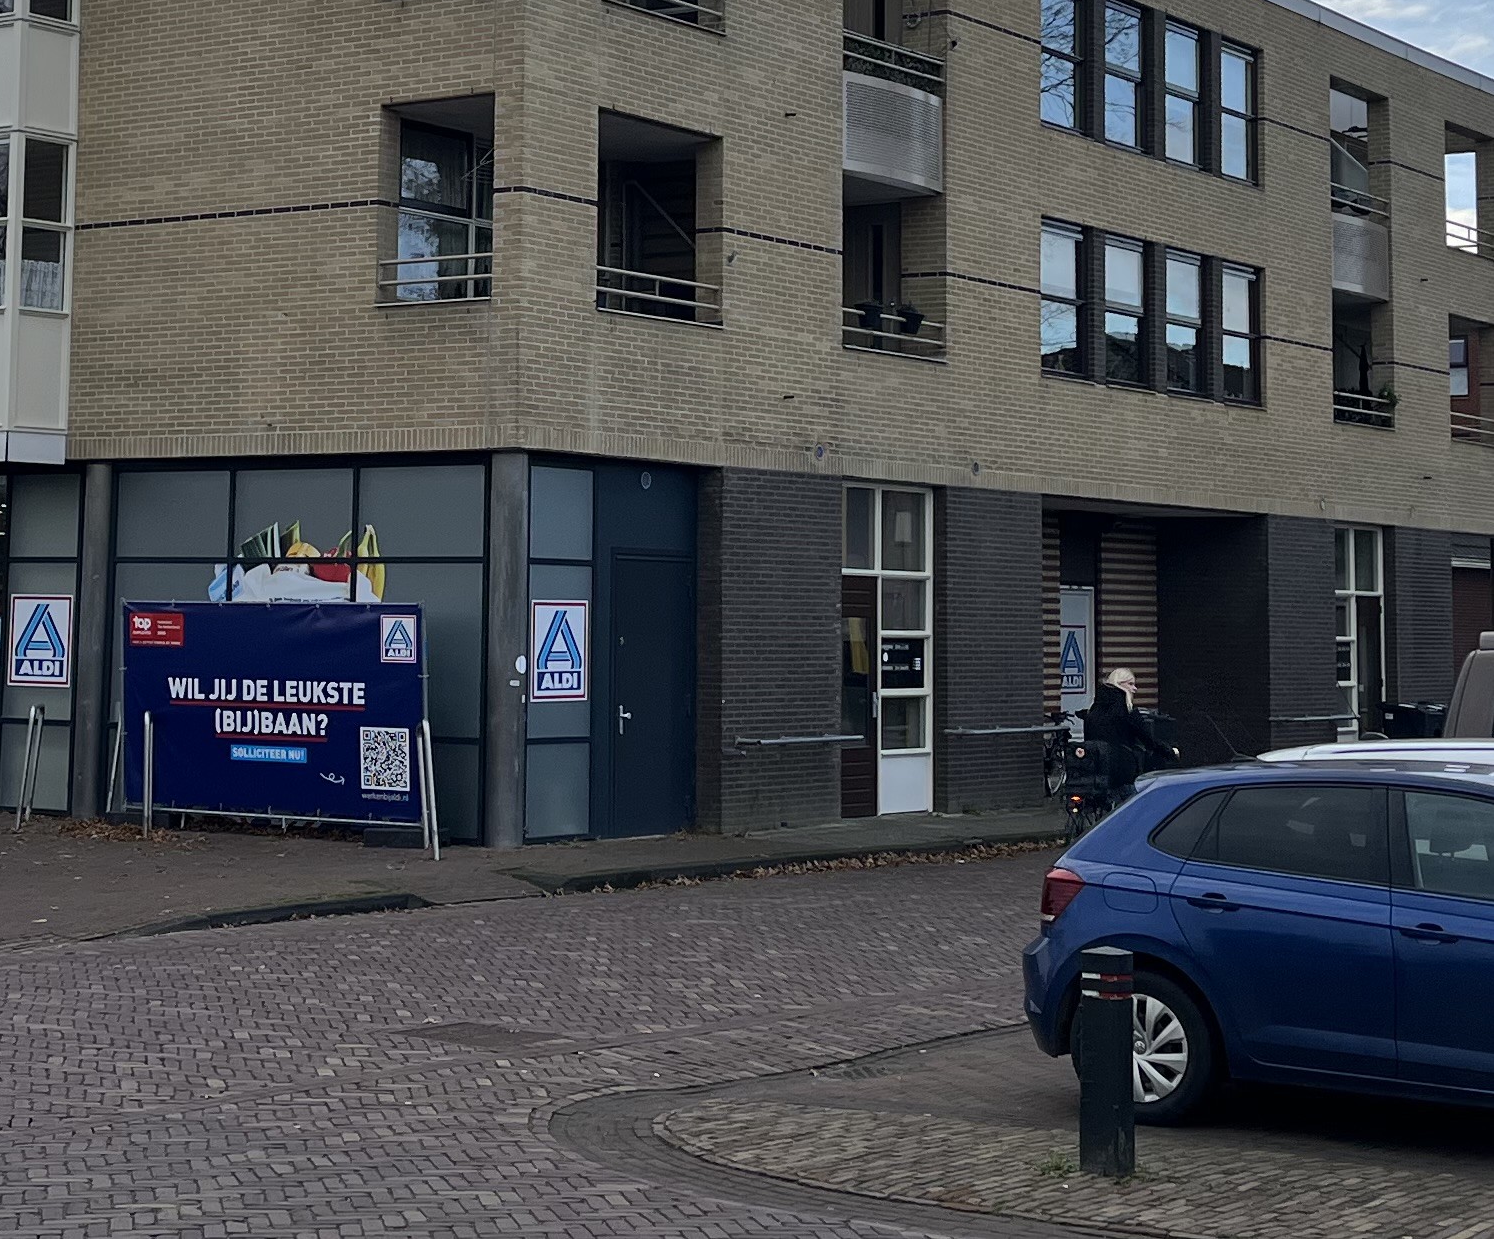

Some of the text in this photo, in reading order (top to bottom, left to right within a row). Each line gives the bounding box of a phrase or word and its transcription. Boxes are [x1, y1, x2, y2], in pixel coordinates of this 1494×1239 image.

[132, 615, 152, 630] top
[387, 648, 411, 657] ALDI
[19, 660, 60, 676] ALDI
[540, 672, 578, 690] ALDI
[1061, 675, 1083, 688] ALDI
[167, 676, 366, 705] WIL JIJ DE LEUKSTE
[215, 708, 329, 736] (BIJ)BAAN?
[232, 747, 305, 761] SOLLICITEER NU!
